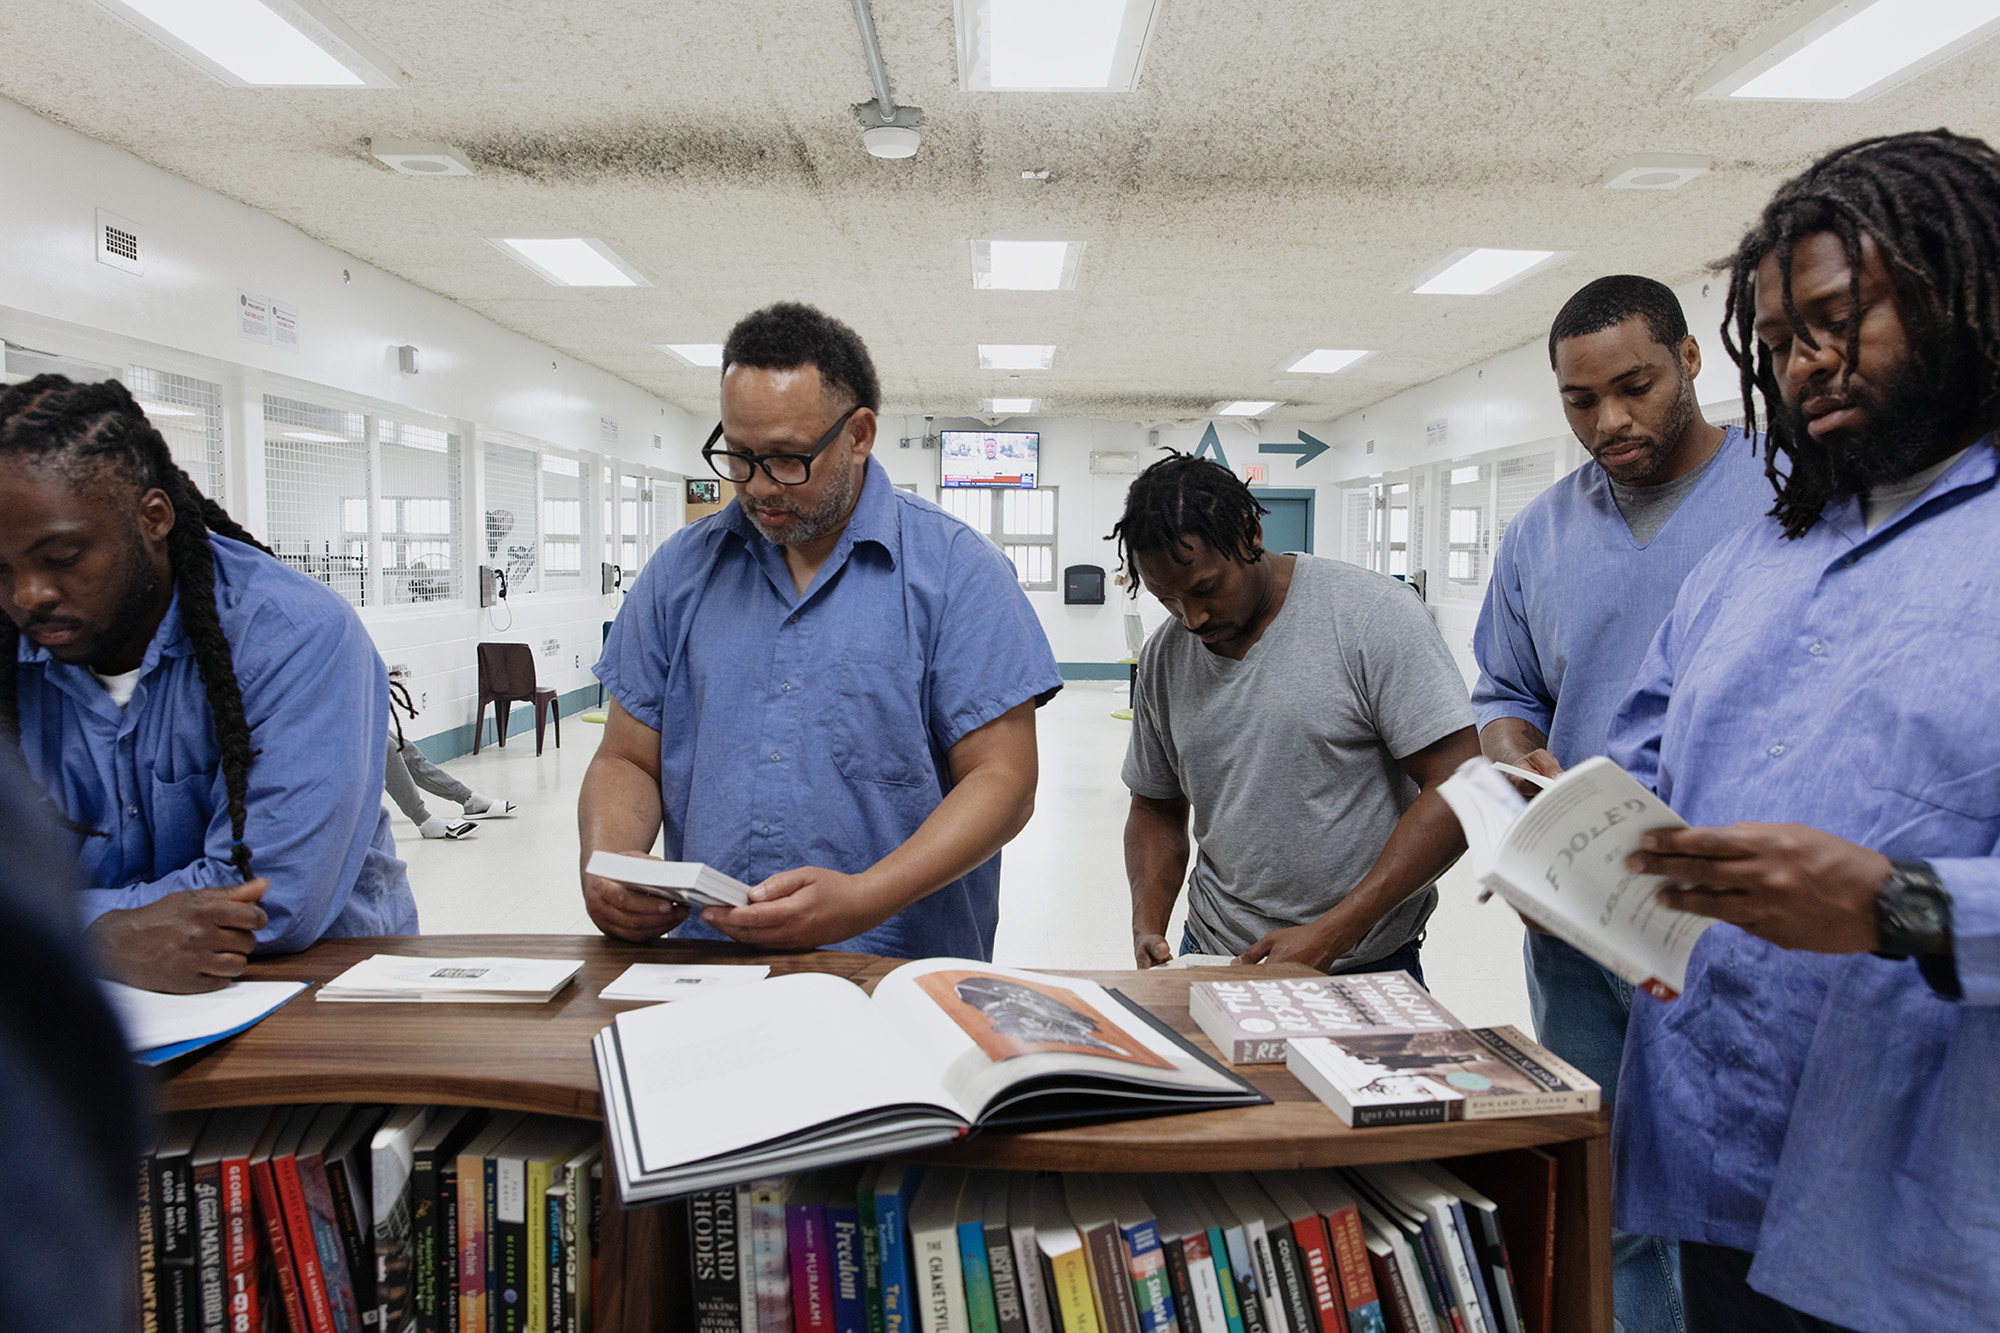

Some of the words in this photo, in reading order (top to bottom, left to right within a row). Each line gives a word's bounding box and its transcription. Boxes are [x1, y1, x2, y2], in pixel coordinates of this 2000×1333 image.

[1193, 421, 1232, 471] A
[1246, 466, 1265, 481] EXIT
[1212, 981, 1262, 1013] THE
[1248, 980, 1320, 1032] RESIDUE
[1281, 979, 1363, 1030] YEARS
[1371, 975, 1453, 1031] JACKSON
[1418, 1107, 1442, 1118] CITY
[162, 1170, 175, 1204] GOOD
[176, 1182, 187, 1203] THE
[229, 1165, 243, 1215] GEORGE
[464, 1179, 475, 1200] Lost
[139, 1205, 153, 1243] SHUT
[177, 1206, 188, 1236] ONLY
[448, 1203, 456, 1218] THE
[465, 1200, 477, 1240] Children
[551, 1200, 559, 1237] STUART
[165, 1206, 177, 1253] INDIANS
[201, 1228, 220, 1267] MAN
[231, 1217, 244, 1267] ORWELL
[448, 1219, 456, 1246] ORDER
[715, 1188, 736, 1281] RICHARD
[140, 1244, 155, 1270] EYE
[305, 1261, 316, 1277] THE
[448, 1247, 456, 1259] OF
[448, 1260, 456, 1278] TIME
[465, 1241, 477, 1276] Archive
[506, 1235, 515, 1284] MICROBE
[551, 1239, 559, 1264] HALL
[566, 1245, 576, 1293] SON
[835, 1222, 859, 1300] Freedom
[1387, 1257, 1397, 1273] THE
[552, 1266, 560, 1286] THE
[805, 1252, 822, 1326] MURAKAMI
[988, 1245, 1021, 1321] DISPATCHES
[1308, 1248, 1334, 1311] ERASURE
[448, 1290, 456, 1316] CARLO
[552, 1287, 561, 1328] FATEFUL
[886, 1284, 900, 1310] THE
[1146, 1278, 1169, 1323] SHADOW
[1244, 1294, 1258, 1323] Tim
